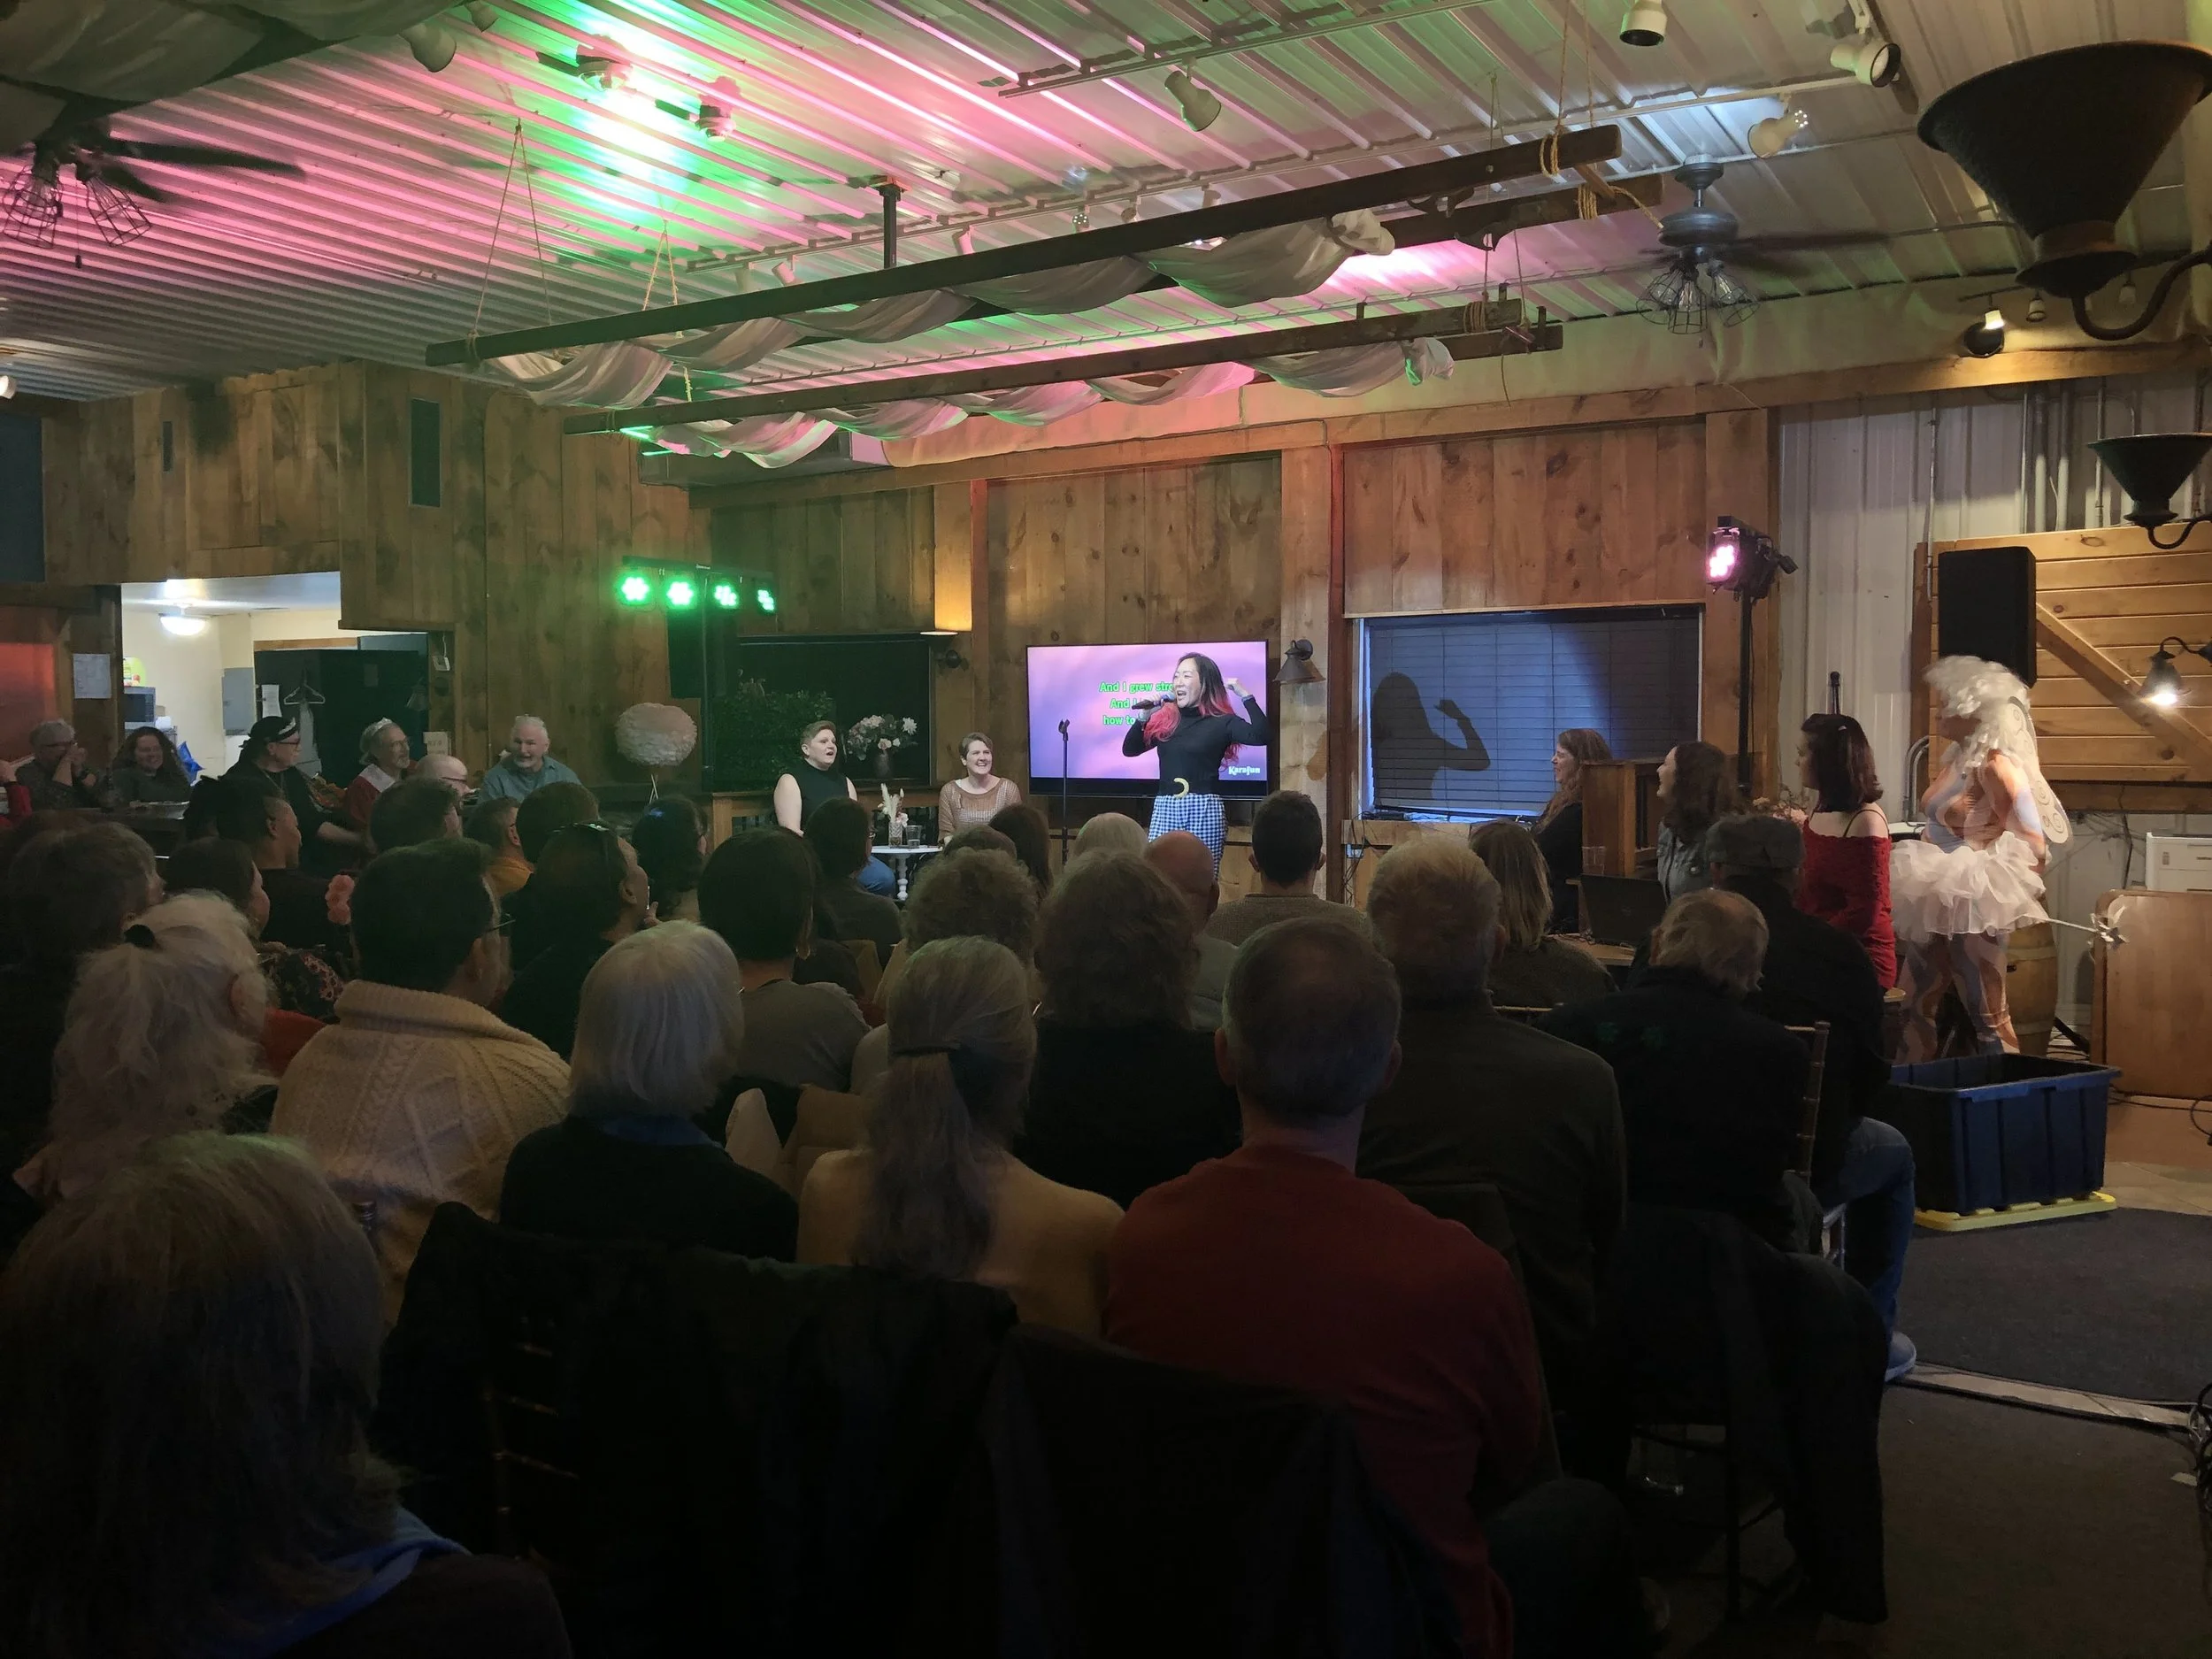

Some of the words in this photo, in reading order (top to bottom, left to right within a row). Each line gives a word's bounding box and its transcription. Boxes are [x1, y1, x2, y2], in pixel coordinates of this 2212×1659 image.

[1099, 681, 1120, 692] And
[1123, 681, 1127, 692] I
[1129, 683, 1153, 694] grew
[1110, 697, 1131, 708] And
[1102, 715, 1124, 725] how
[1125, 715, 1136, 725] to
